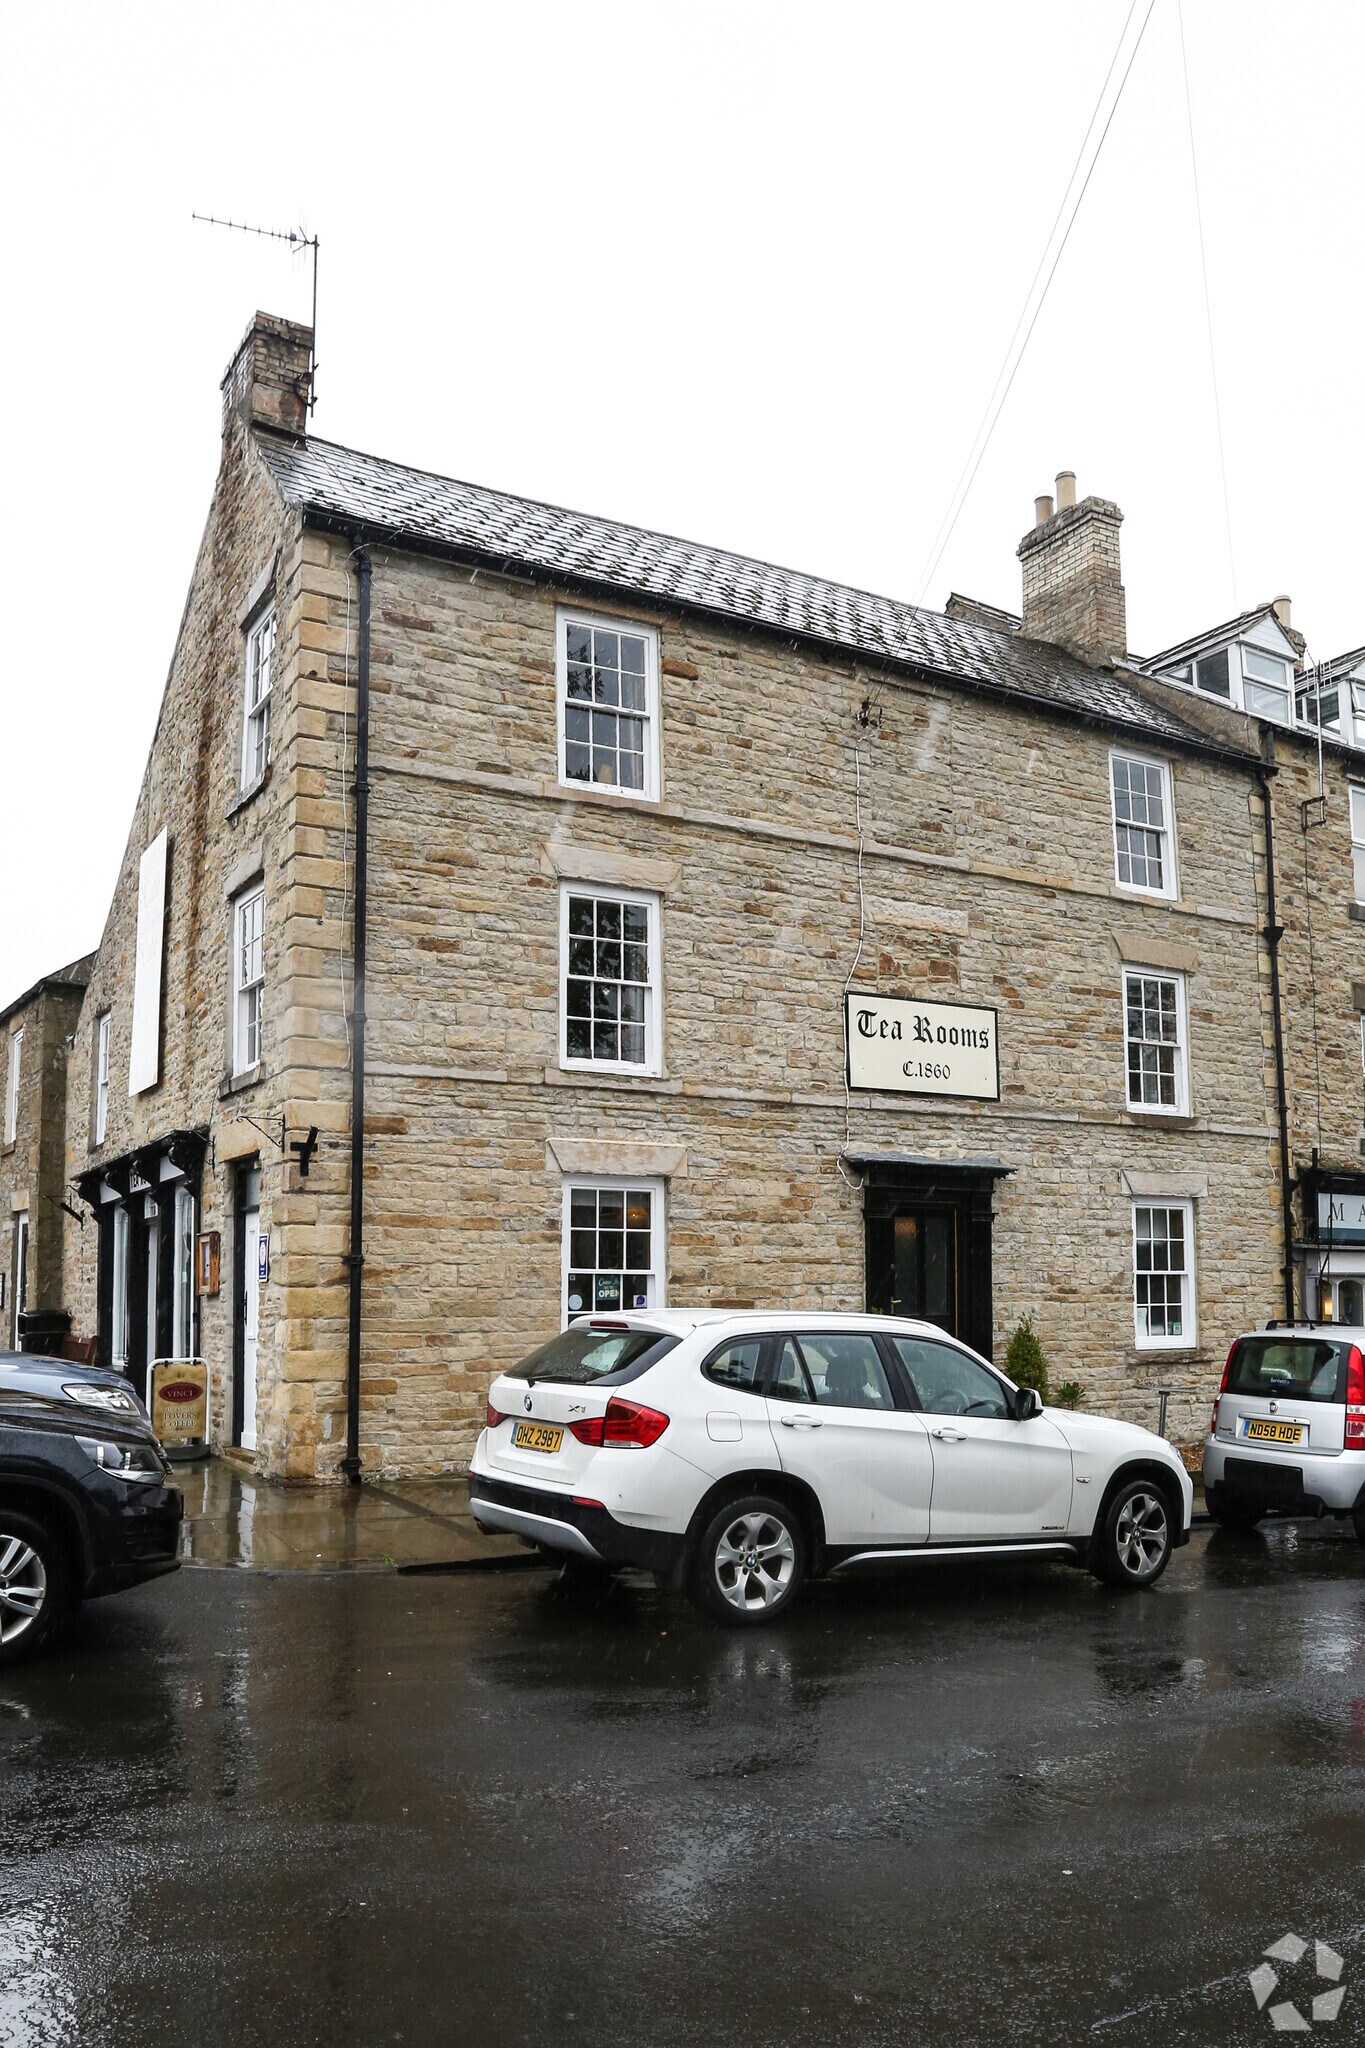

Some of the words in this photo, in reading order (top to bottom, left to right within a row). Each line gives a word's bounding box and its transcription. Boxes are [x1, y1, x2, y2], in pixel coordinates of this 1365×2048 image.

[856, 1009, 902, 1040] Tea
[912, 1015, 989, 1049] Rooms
[902, 1060, 951, 1079] C.1860
[568, 1404, 587, 1413] X1
[163, 1420, 196, 1428] COFFEE
[1250, 1423, 1276, 1437] ND58
[1278, 1427, 1301, 1440] HDE
[516, 1426, 535, 1444] OHZ
[534, 1429, 561, 1449] 2987
